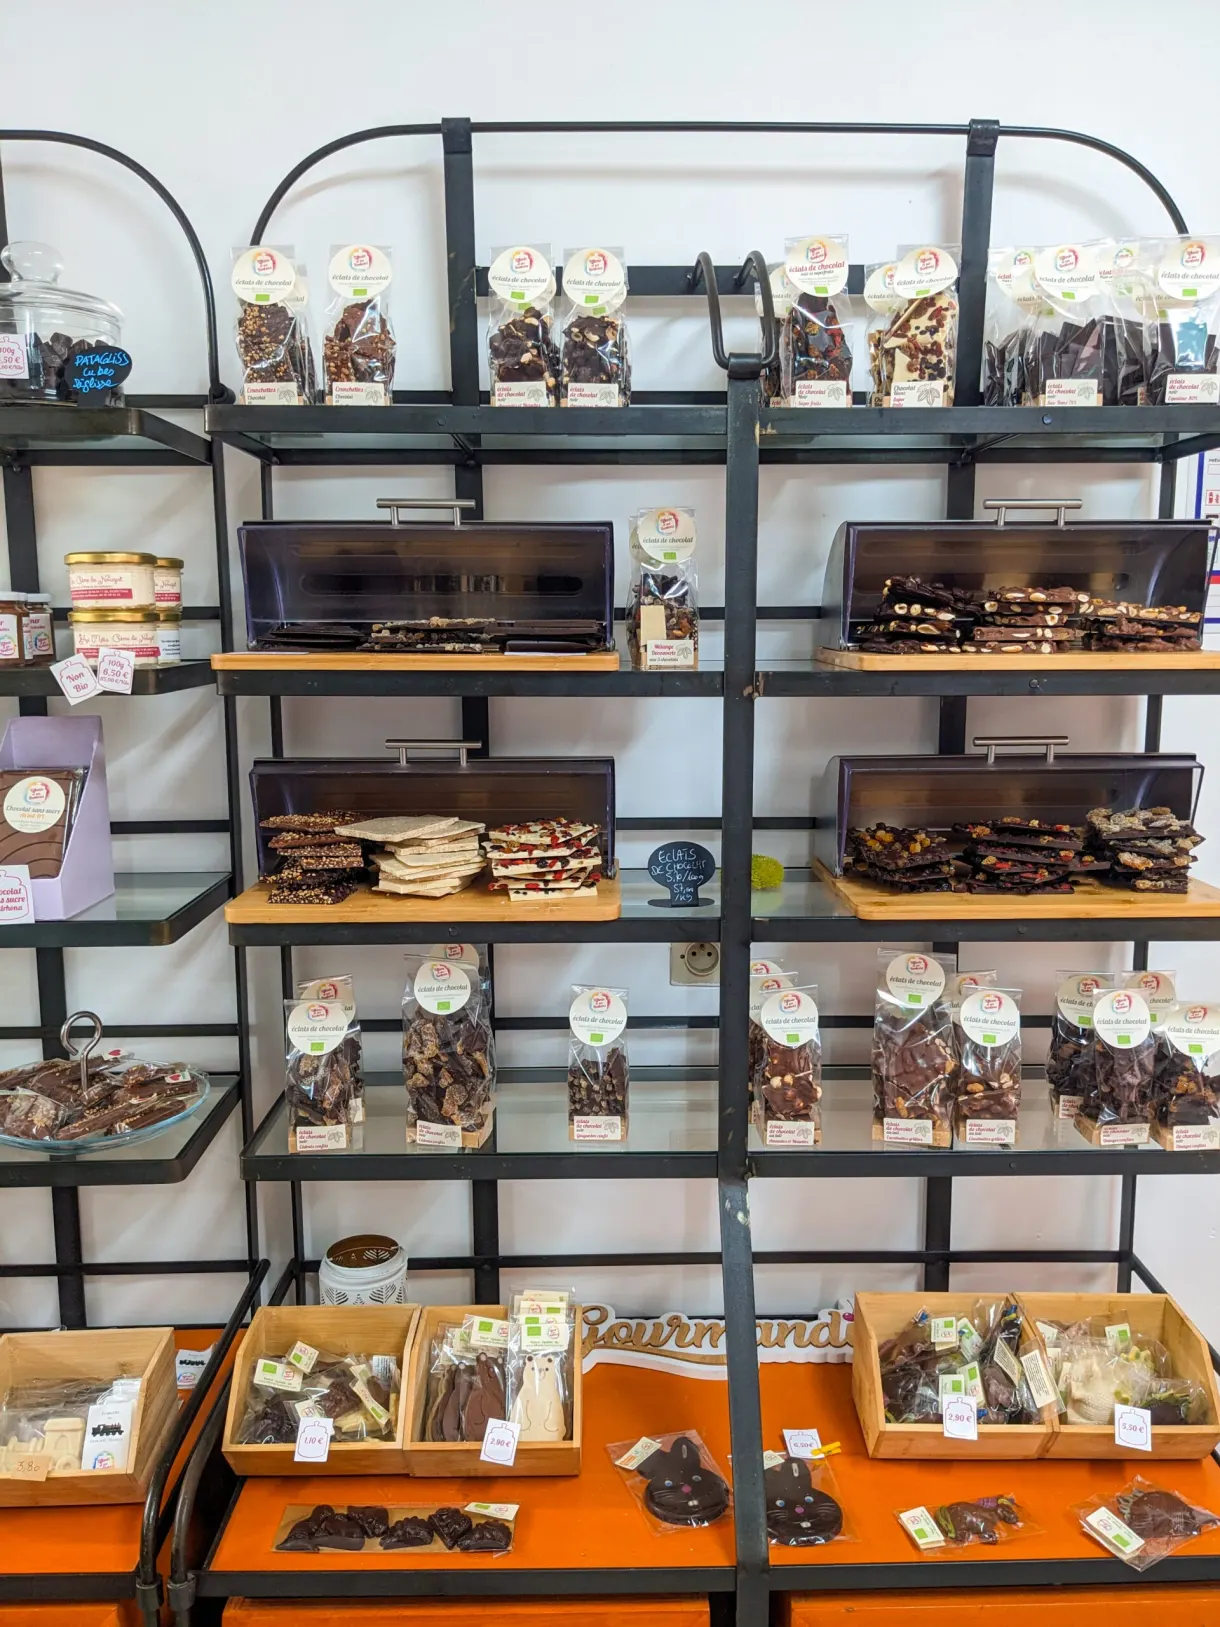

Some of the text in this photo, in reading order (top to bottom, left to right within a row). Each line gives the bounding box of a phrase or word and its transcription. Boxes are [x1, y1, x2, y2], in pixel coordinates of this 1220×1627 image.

[817, 261, 845, 270] chocolat
[108, 660, 124, 670] 100g
[66, 671, 85, 683] Non
[73, 683, 88, 692] Bio
[651, 865, 664, 875] DE
